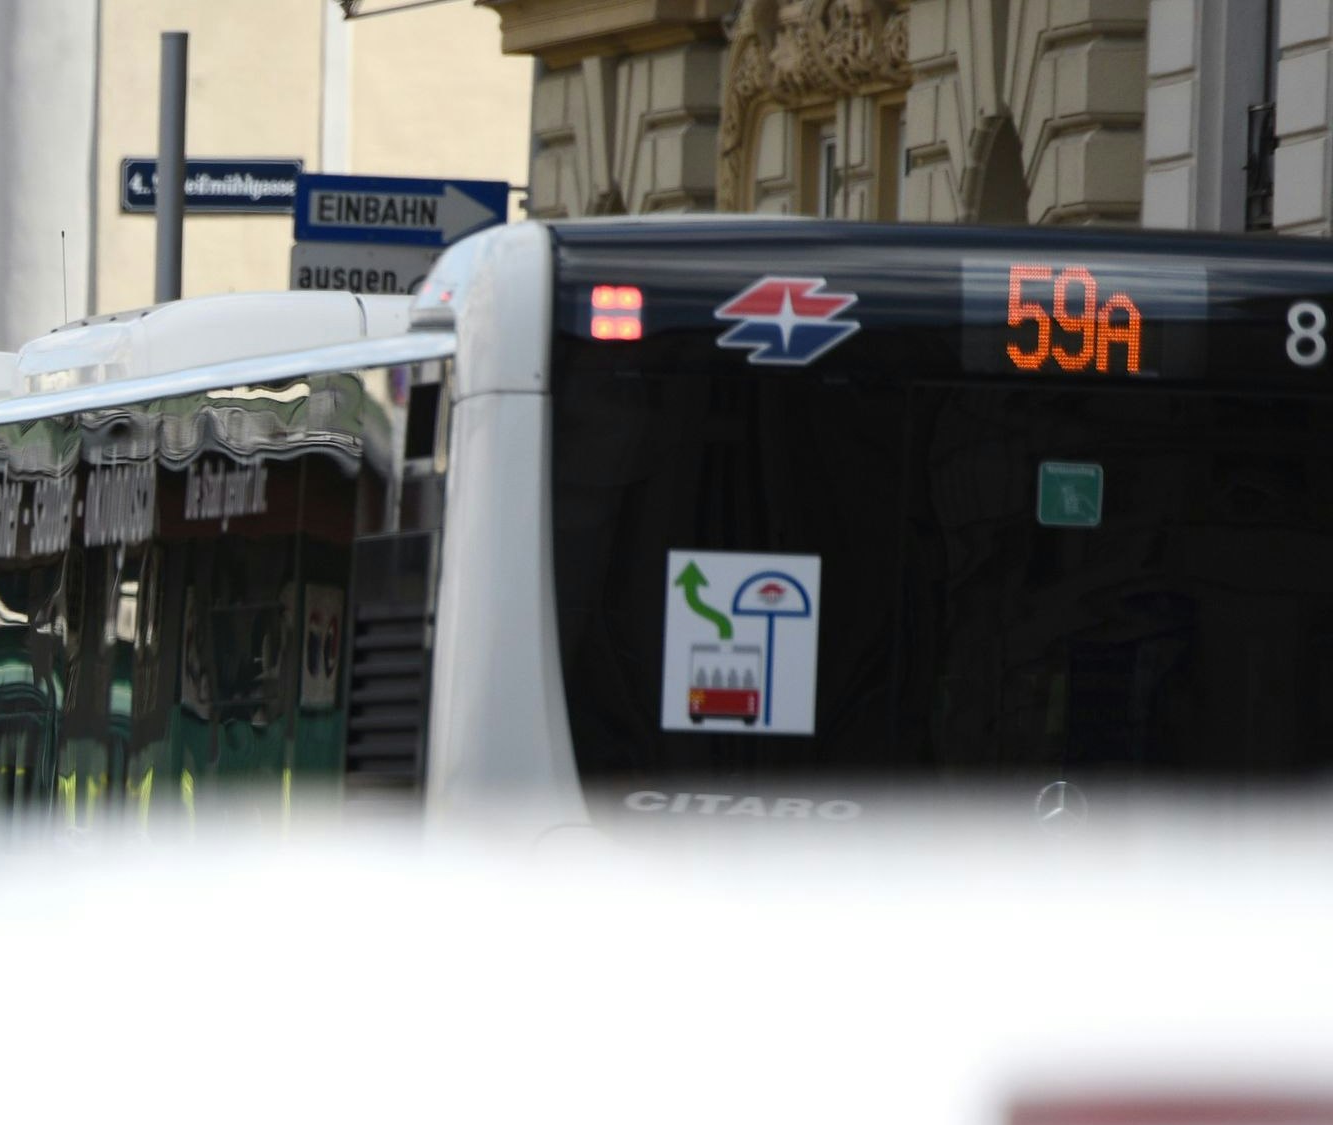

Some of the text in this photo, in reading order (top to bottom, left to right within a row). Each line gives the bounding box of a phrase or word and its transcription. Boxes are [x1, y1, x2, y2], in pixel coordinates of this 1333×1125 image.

[317, 194, 438, 226] EINBAHN
[298, 265, 406, 295] ausgen.
[1006, 264, 1142, 375] 59A
[1285, 301, 1327, 366] 8
[623, 790, 862, 821] CITARO
